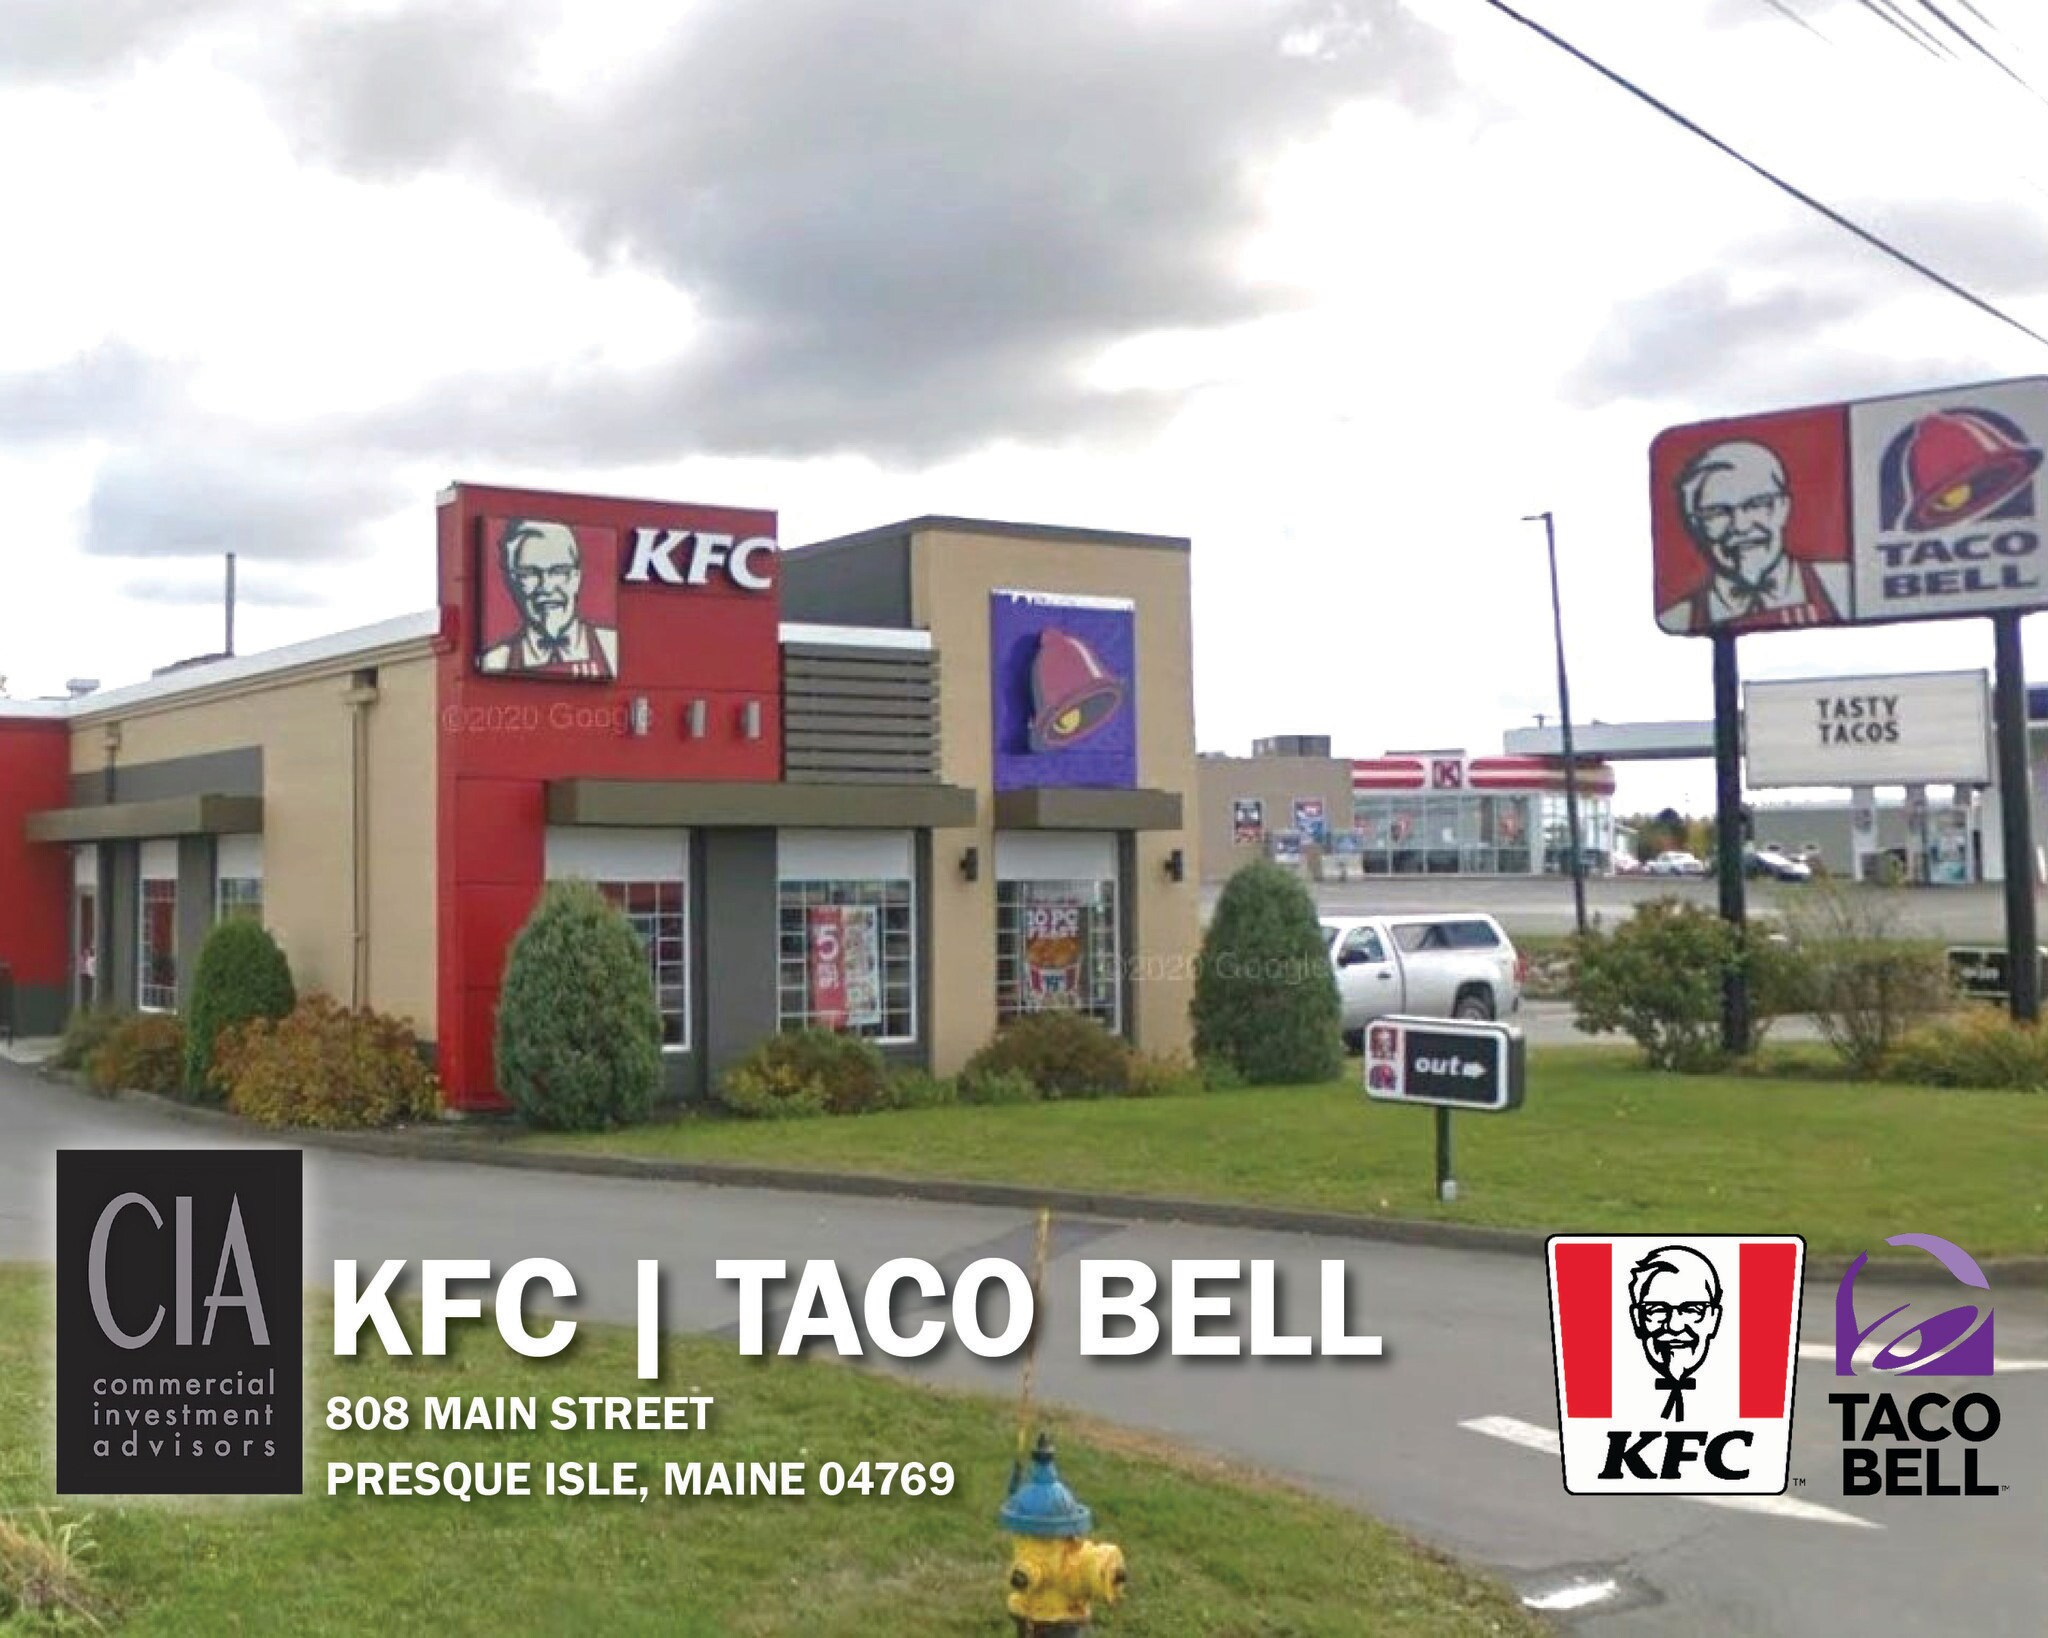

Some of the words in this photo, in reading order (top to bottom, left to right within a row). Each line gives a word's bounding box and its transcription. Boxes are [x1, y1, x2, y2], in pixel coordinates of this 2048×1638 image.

[624, 527, 776, 589] KFC
[1874, 530, 2039, 568] TACO
[1883, 564, 2039, 598] BELL
[1816, 695, 1899, 719] TASTY
[1818, 721, 1900, 745] TACOS
[1436, 760, 1461, 789] K
[1415, 1056, 1461, 1077] out
